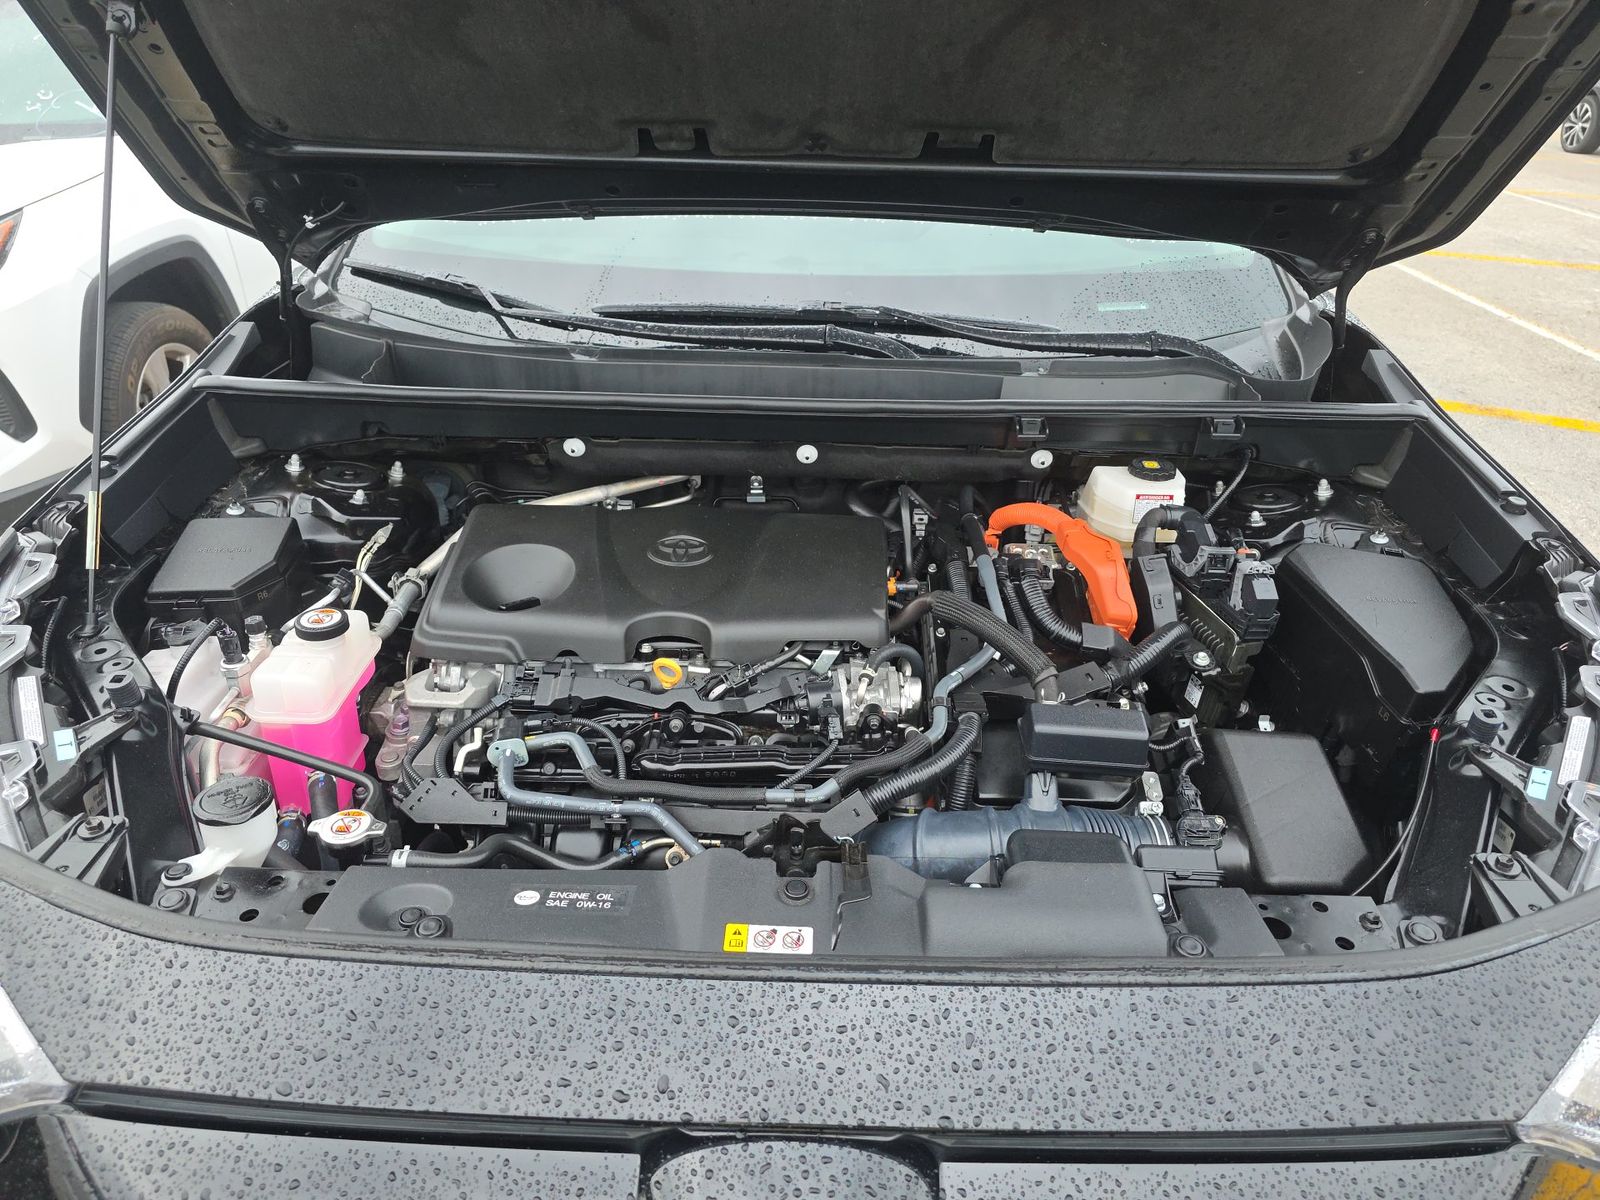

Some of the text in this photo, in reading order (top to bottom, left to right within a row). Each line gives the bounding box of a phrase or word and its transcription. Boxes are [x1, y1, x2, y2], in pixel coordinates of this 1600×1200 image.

[549, 891, 591, 901] ENGINE
[596, 893, 615, 901] OIL
[545, 899, 570, 908] SAE
[576, 901, 612, 909] 0W-16
